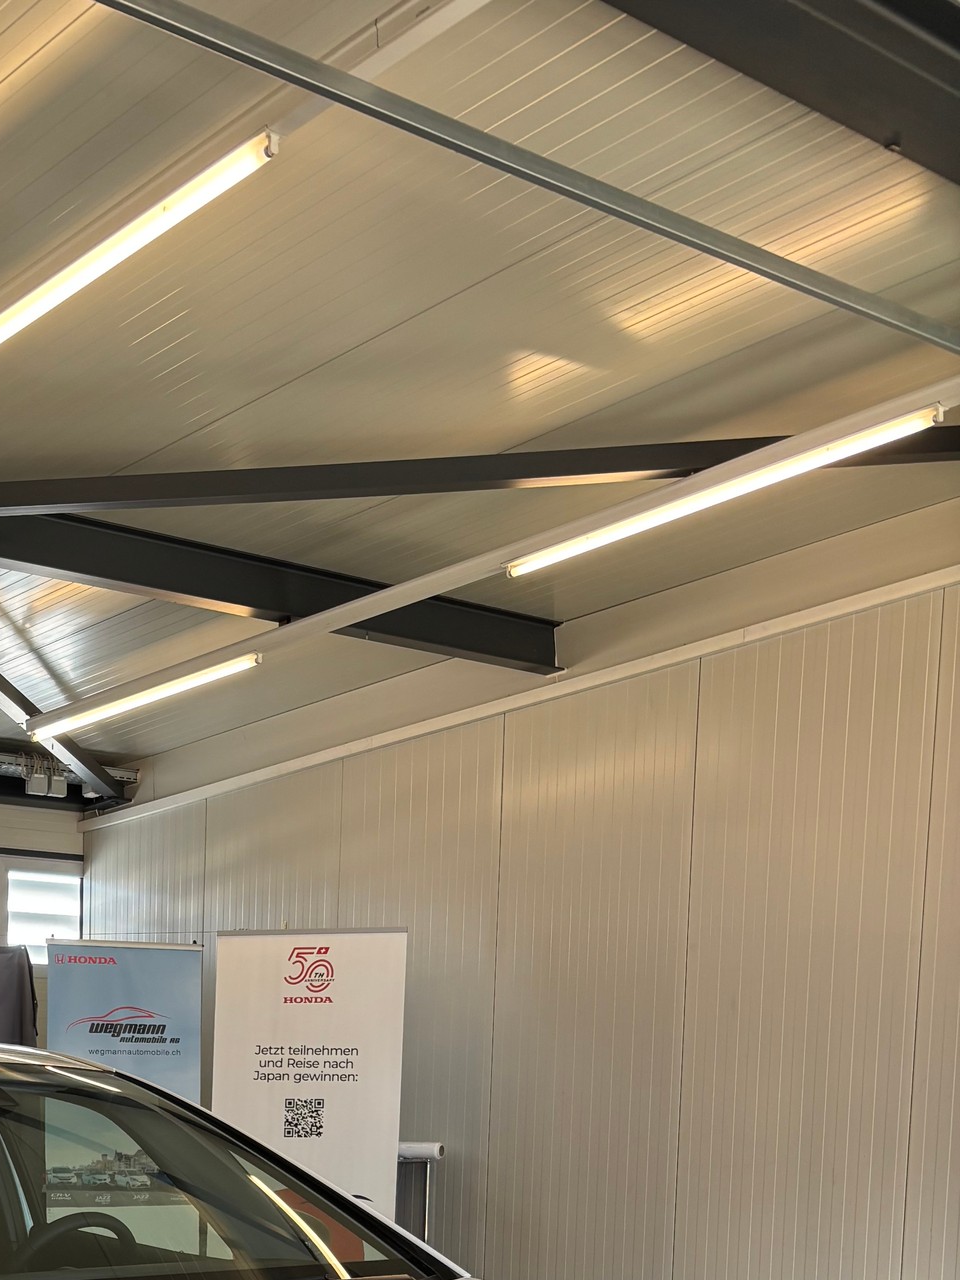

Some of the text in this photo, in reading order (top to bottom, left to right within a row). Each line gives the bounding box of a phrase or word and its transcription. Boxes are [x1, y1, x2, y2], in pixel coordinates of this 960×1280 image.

[67, 955, 117, 965] HONDA
[283, 996, 334, 1004] HONDA
[88, 1022, 167, 1038] wegmann
[119, 1035, 167, 1044] automobile
[254, 1045, 359, 1056] Jetzt teilnehmen
[259, 1058, 354, 1069] und Reise nach
[253, 1071, 359, 1084] Japan gewinnen:
